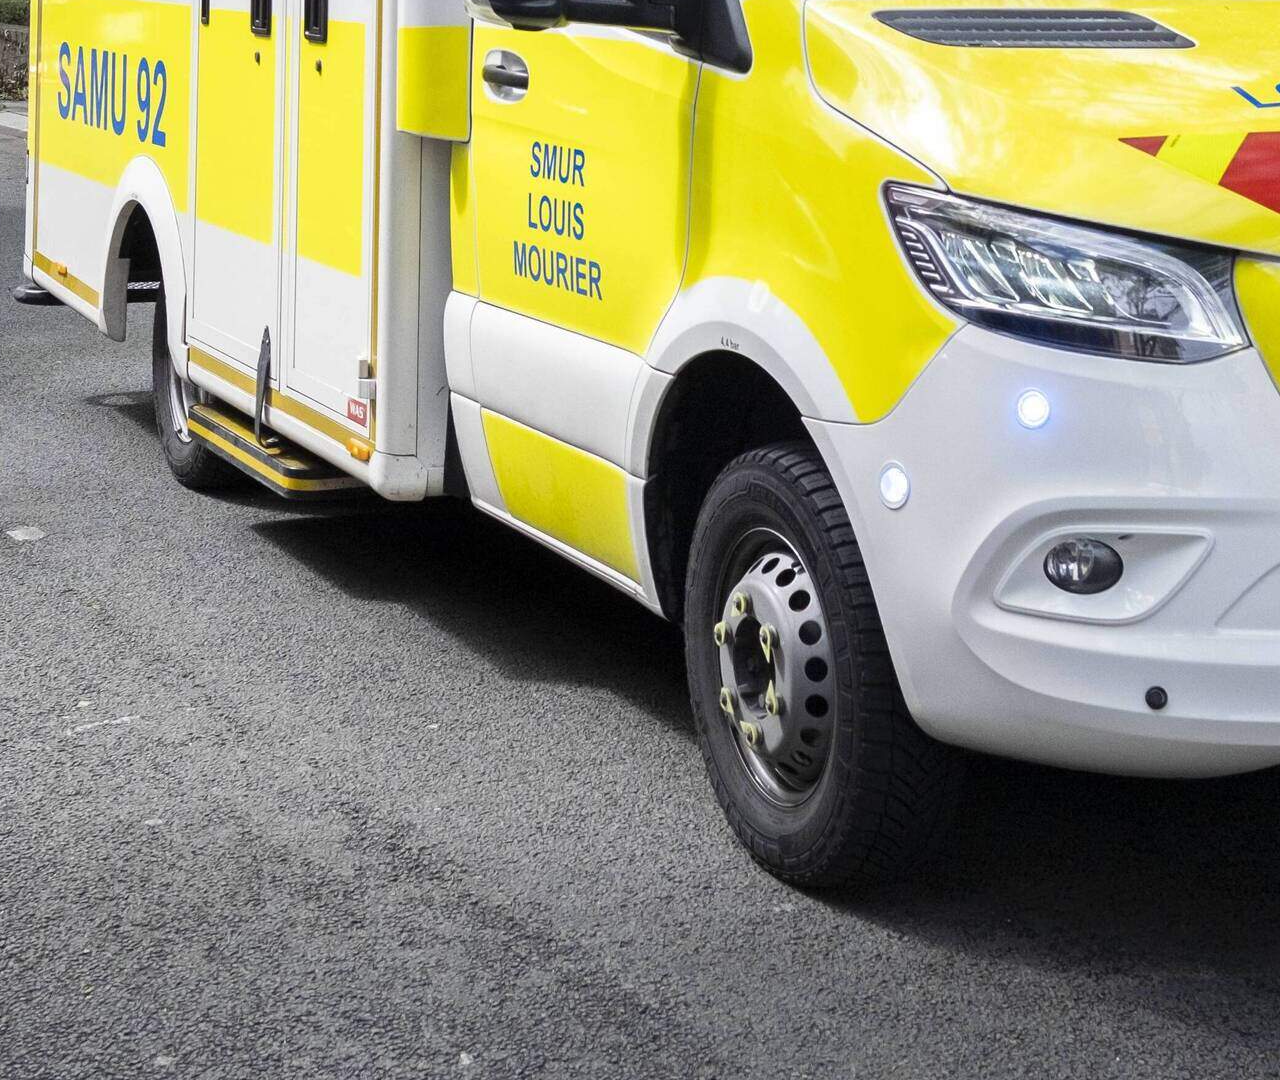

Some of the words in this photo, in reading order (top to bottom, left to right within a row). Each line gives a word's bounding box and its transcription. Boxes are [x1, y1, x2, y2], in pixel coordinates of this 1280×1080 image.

[57, 41, 126, 136] SAMU
[136, 56, 168, 148] 92
[529, 141, 586, 187] SMUR
[527, 192, 585, 241] LOUIS
[513, 241, 603, 301] MOURIER
[349, 400, 365, 419] WAS
